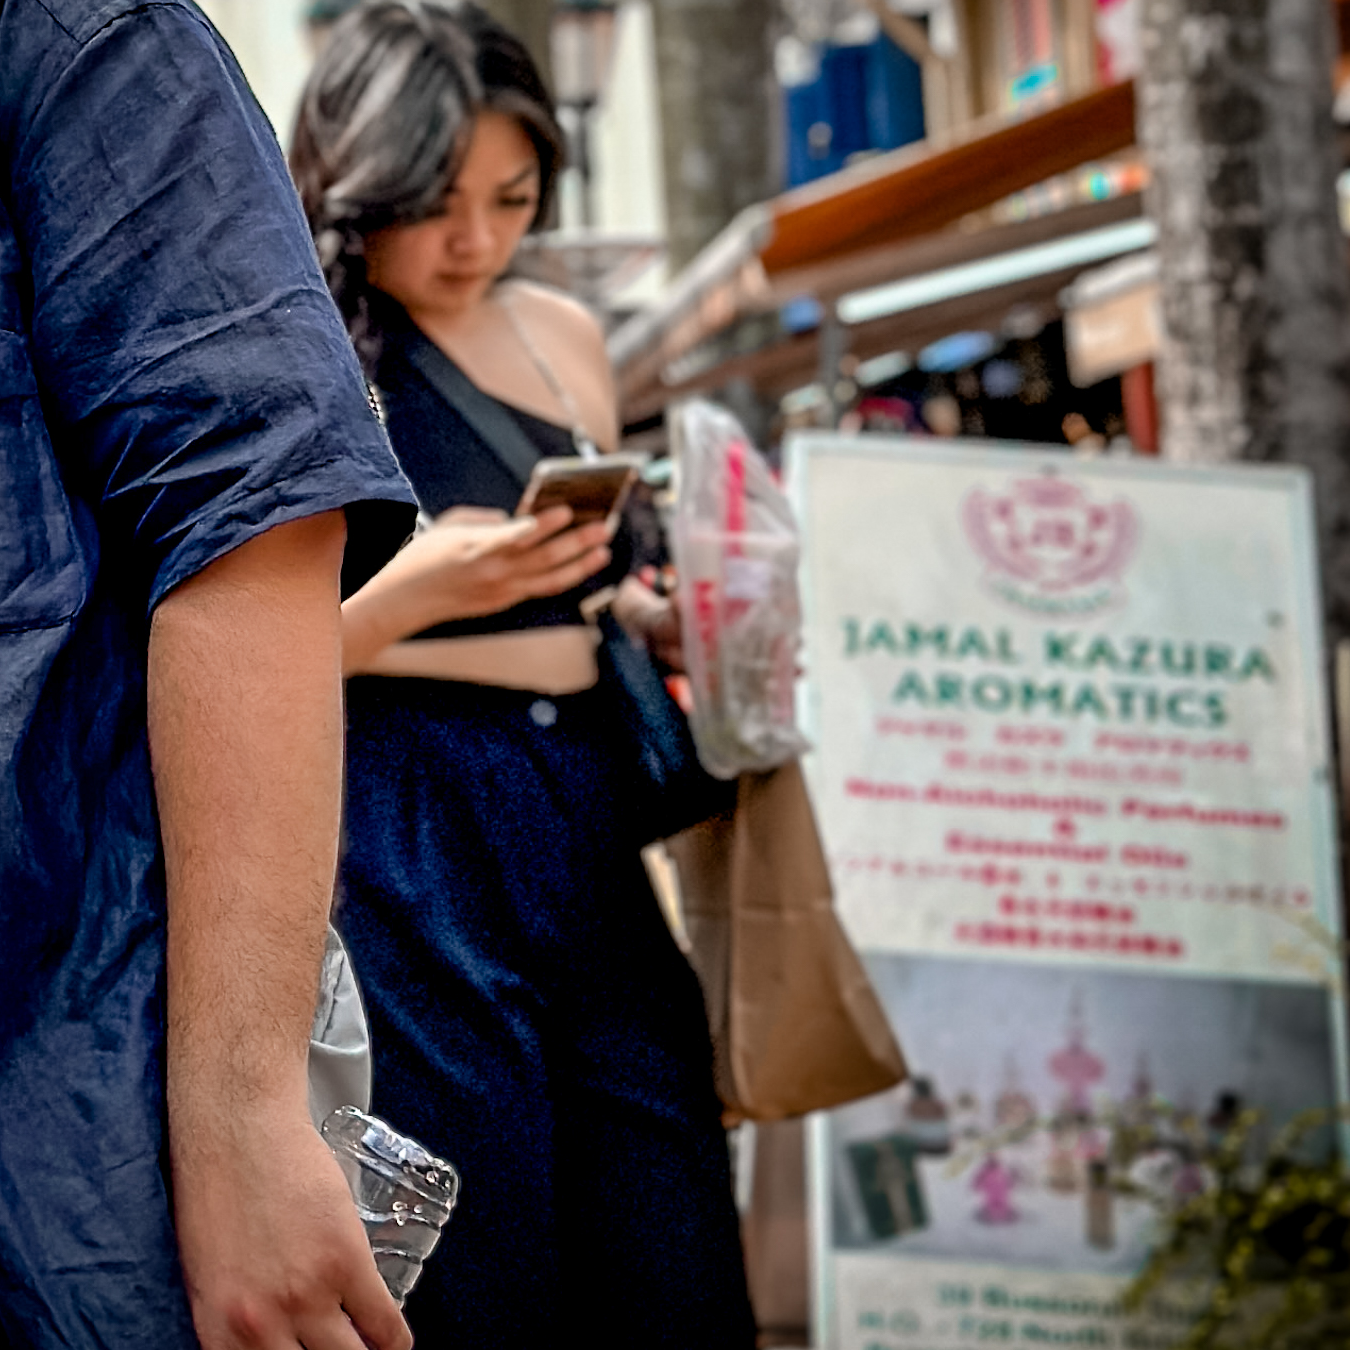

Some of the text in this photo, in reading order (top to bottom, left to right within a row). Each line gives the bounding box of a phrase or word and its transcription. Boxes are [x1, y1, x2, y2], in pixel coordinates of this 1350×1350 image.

[844, 619, 1276, 684] JAMAL KAZURA
[893, 668, 1229, 728] AROMATICS
